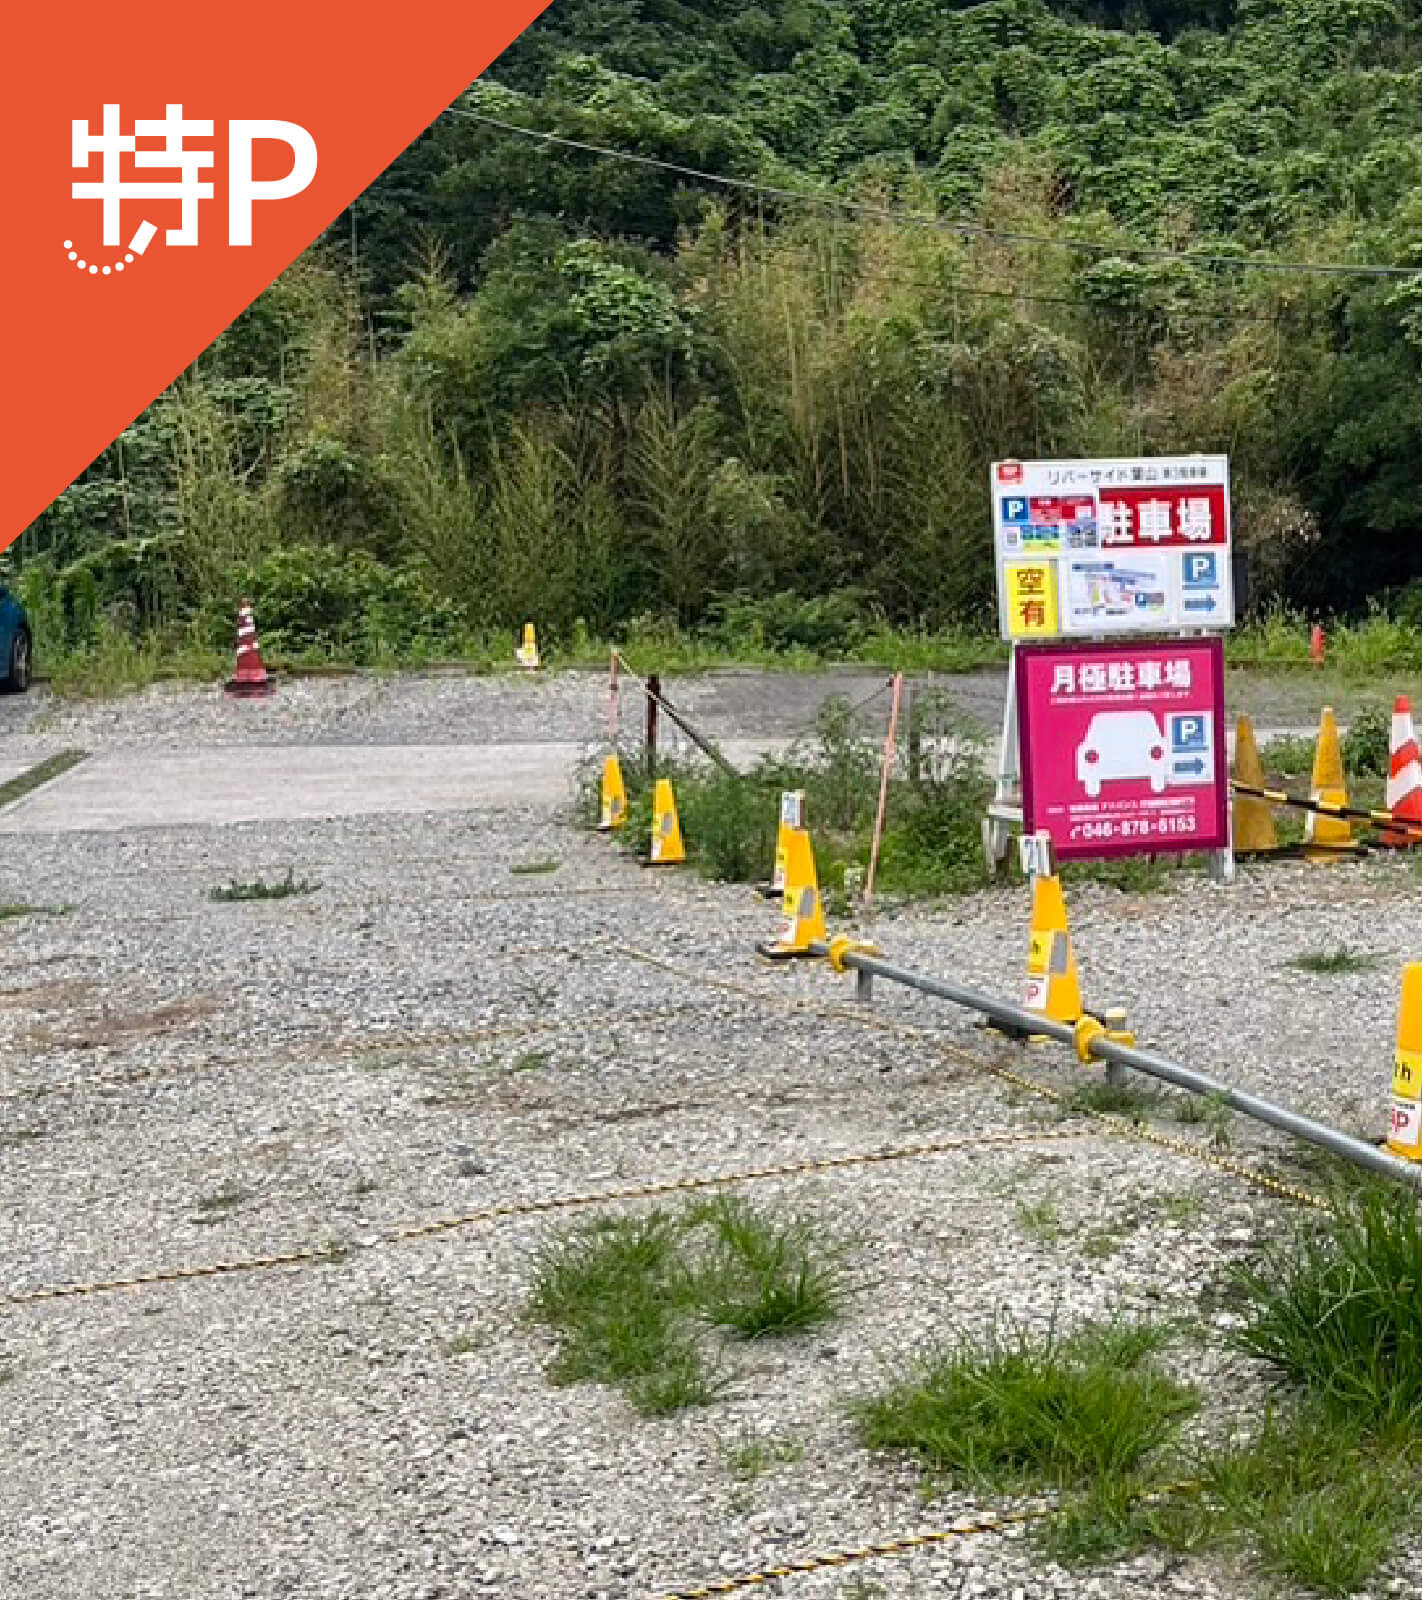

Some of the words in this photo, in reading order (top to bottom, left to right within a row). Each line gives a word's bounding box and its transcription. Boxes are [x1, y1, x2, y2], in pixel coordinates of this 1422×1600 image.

[1008, 500, 1024, 522] P
[1099, 496, 1213, 544] 駐車場
[1193, 558, 1210, 581] P
[1050, 659, 1192, 693] 月極駐車場
[1181, 720, 1198, 742] P
